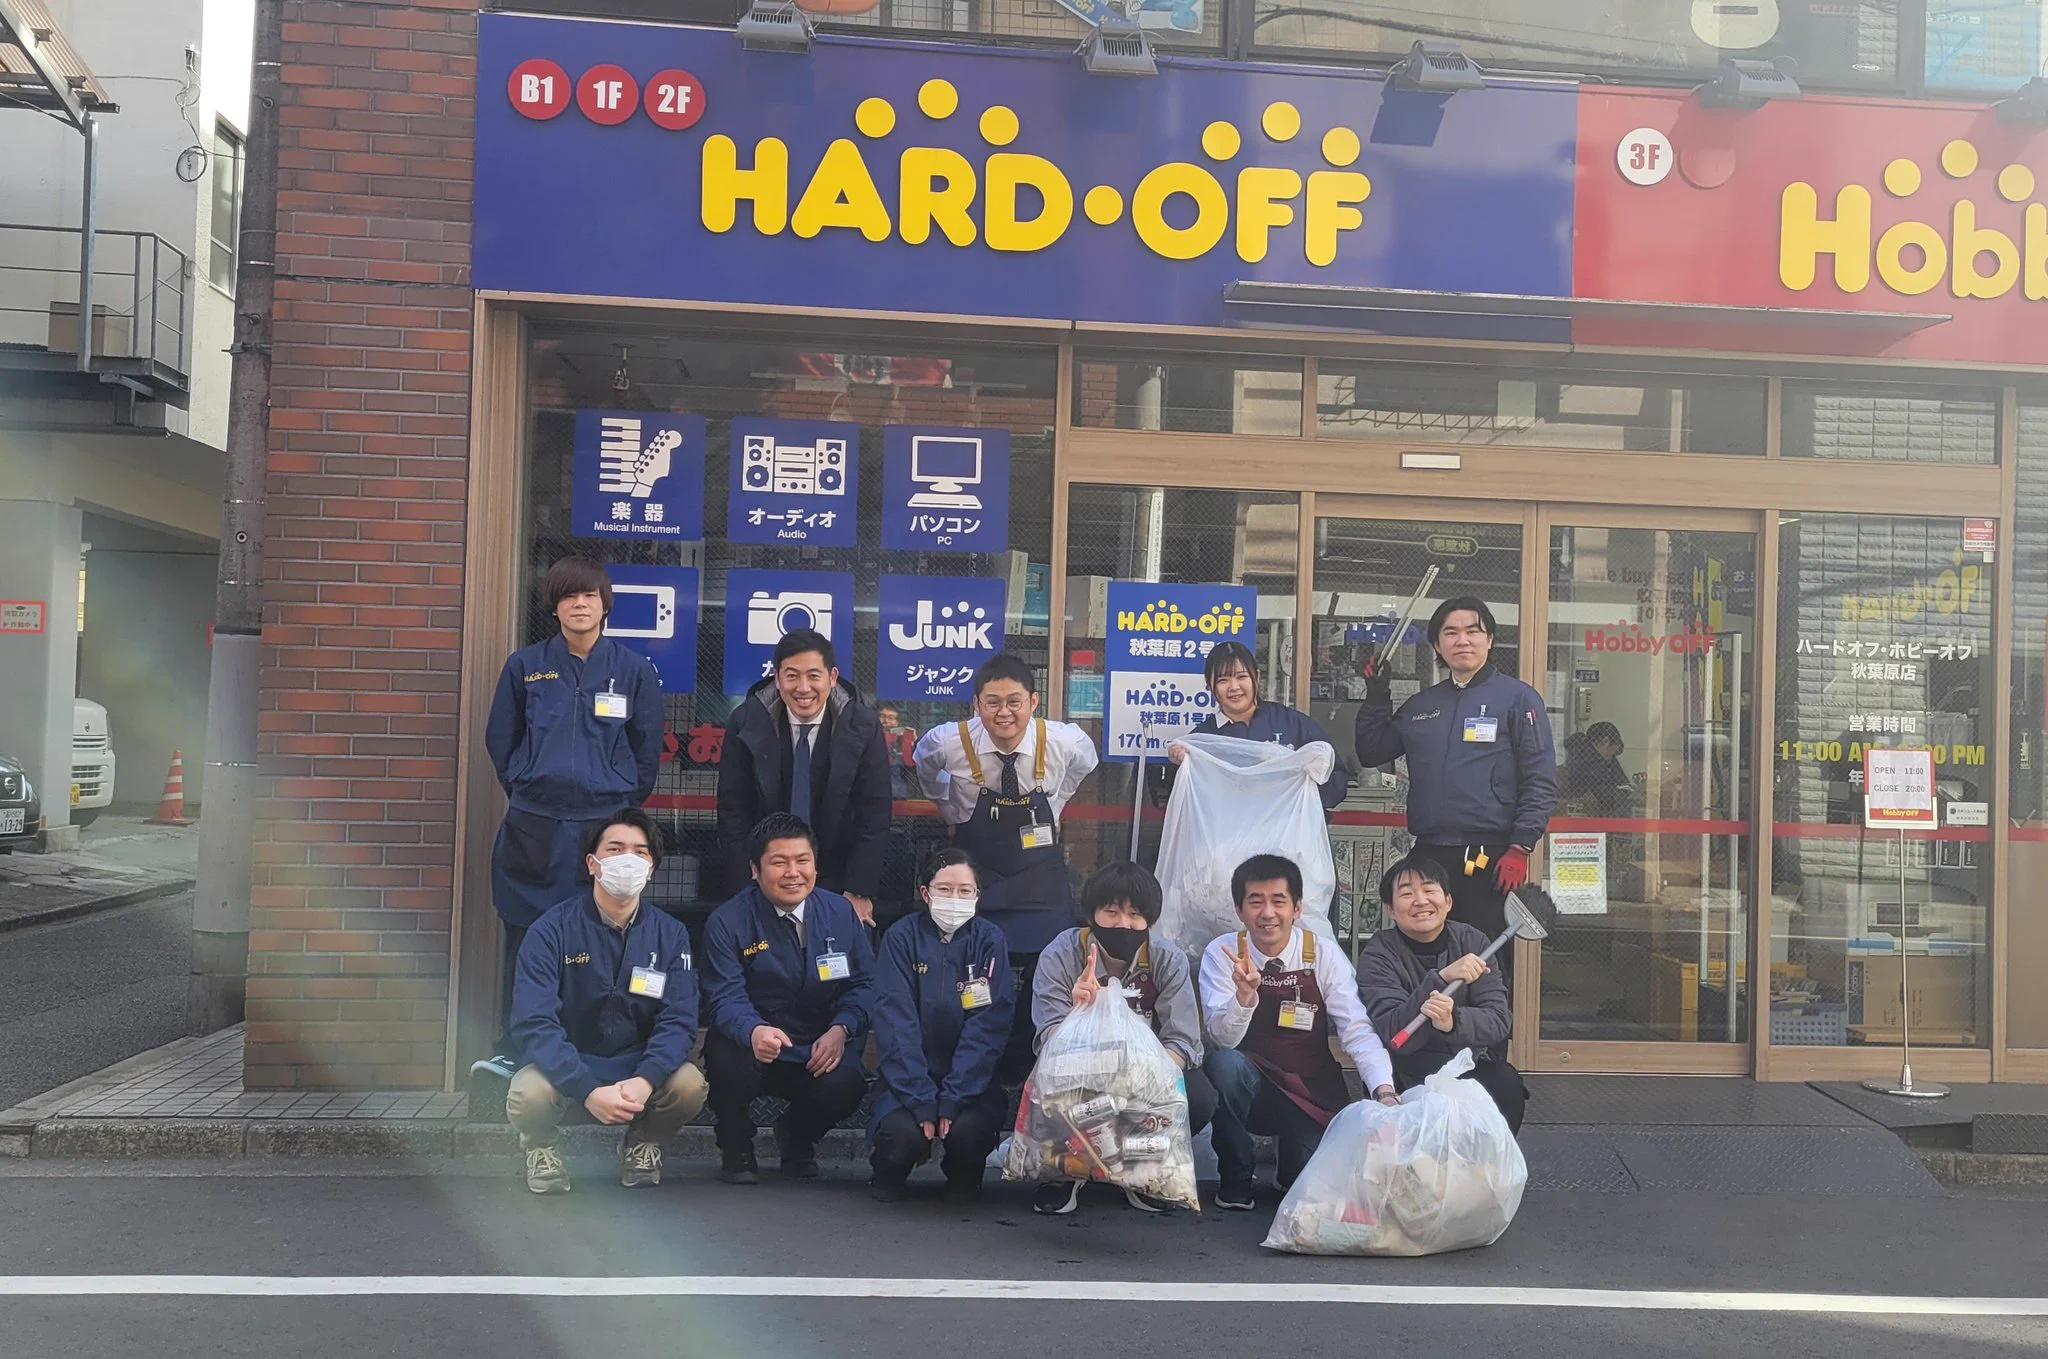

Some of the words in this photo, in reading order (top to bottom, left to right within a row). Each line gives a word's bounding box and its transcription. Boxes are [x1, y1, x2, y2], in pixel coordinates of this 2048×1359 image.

[520, 75, 555, 104] B1
[593, 81, 623, 110] 1F
[657, 84, 691, 114] 2F
[1629, 142, 1661, 171] 3F
[610, 501, 665, 522] 楽器
[747, 510, 836, 529] オーディオ
[594, 521, 629, 533] Musical
[631, 523, 680, 535] Instrument
[909, 514, 980, 533] パソコン
[777, 529, 806, 539] Audio
[936, 535, 952, 545] PC
[888, 599, 993, 650] JUNK
[1128, 638, 1222, 659] 秋葉原2号
[905, 665, 975, 684] ジャンク
[1850, 662, 1917, 682] 秋葉原店
[925, 684, 954, 695] JUNK
[1848, 715, 1917, 733] 営業時間
[1779, 740, 1842, 762] 11:00
[1952, 745, 1985, 766] PM
[1874, 766, 1896, 775] OPEN
[1904, 767, 1924, 775] 11:00
[1873, 784, 1899, 792] CLOSE
[1905, 785, 1925, 793] 20:00
